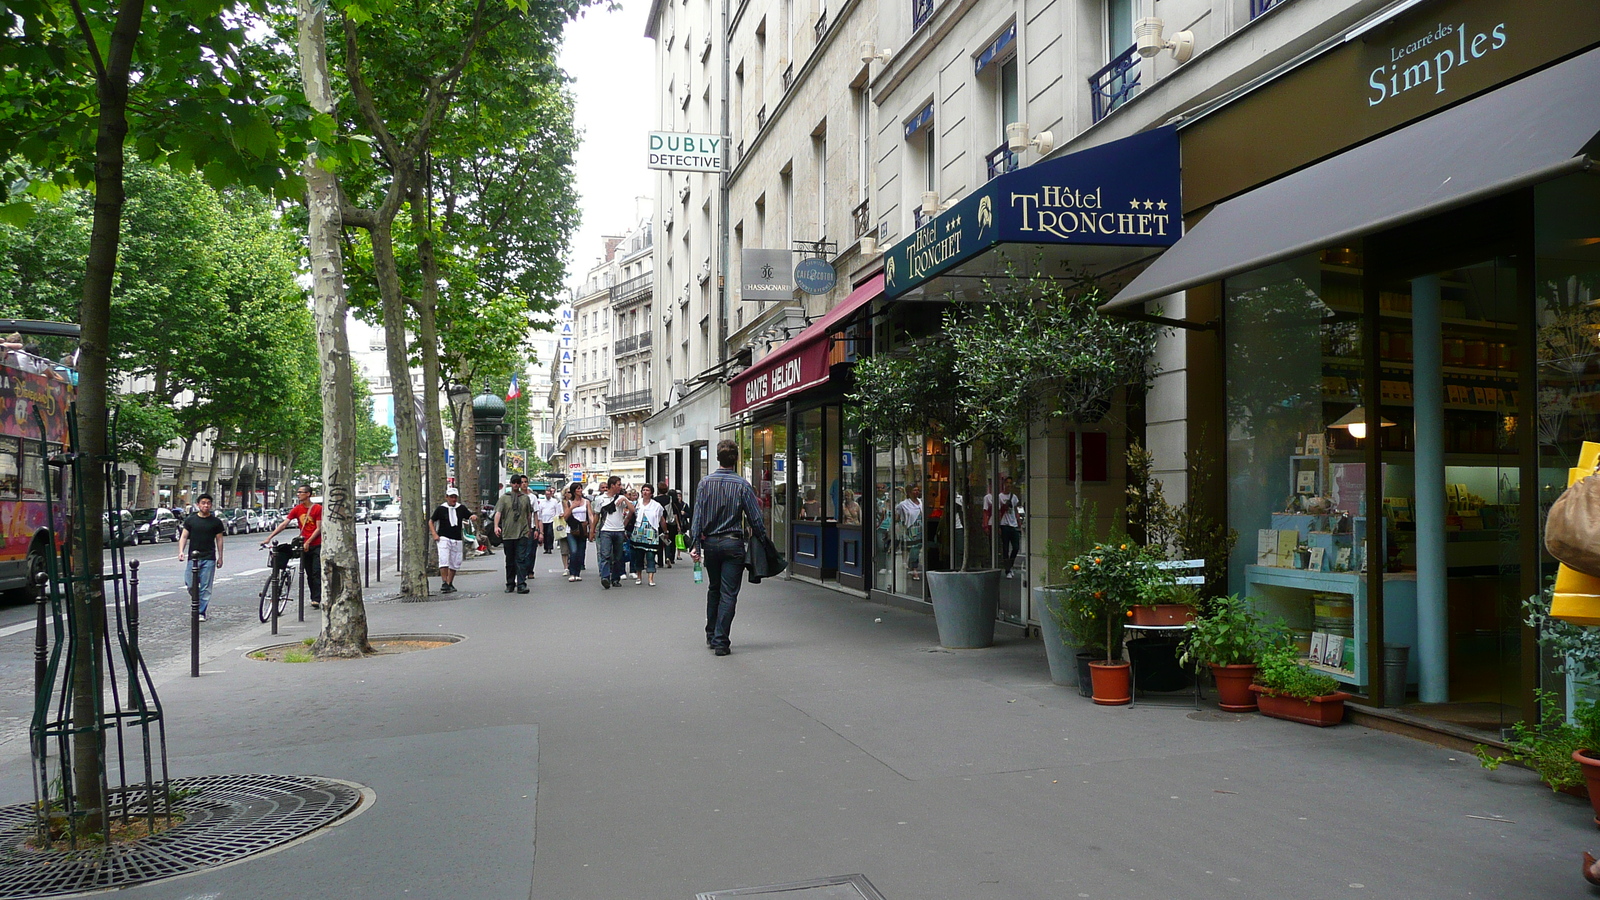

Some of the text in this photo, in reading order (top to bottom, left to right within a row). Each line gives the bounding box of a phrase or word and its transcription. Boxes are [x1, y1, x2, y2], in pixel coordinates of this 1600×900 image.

[1391, 23, 1453, 62] Le carré des
[1368, 22, 1507, 107] Simples
[649, 134, 720, 154] DUBLY
[649, 153, 721, 169] DETECTIVE
[1042, 185, 1102, 209] Hôtel
[1011, 191, 1169, 239] TRONCHET
[916, 219, 937, 252] Hôtel
[906, 229, 962, 279] TRONCHET
[744, 283, 791, 292] CHASSAGNARD
[562, 309, 572, 402] NATALYS
[745, 373, 768, 404] GANTS
